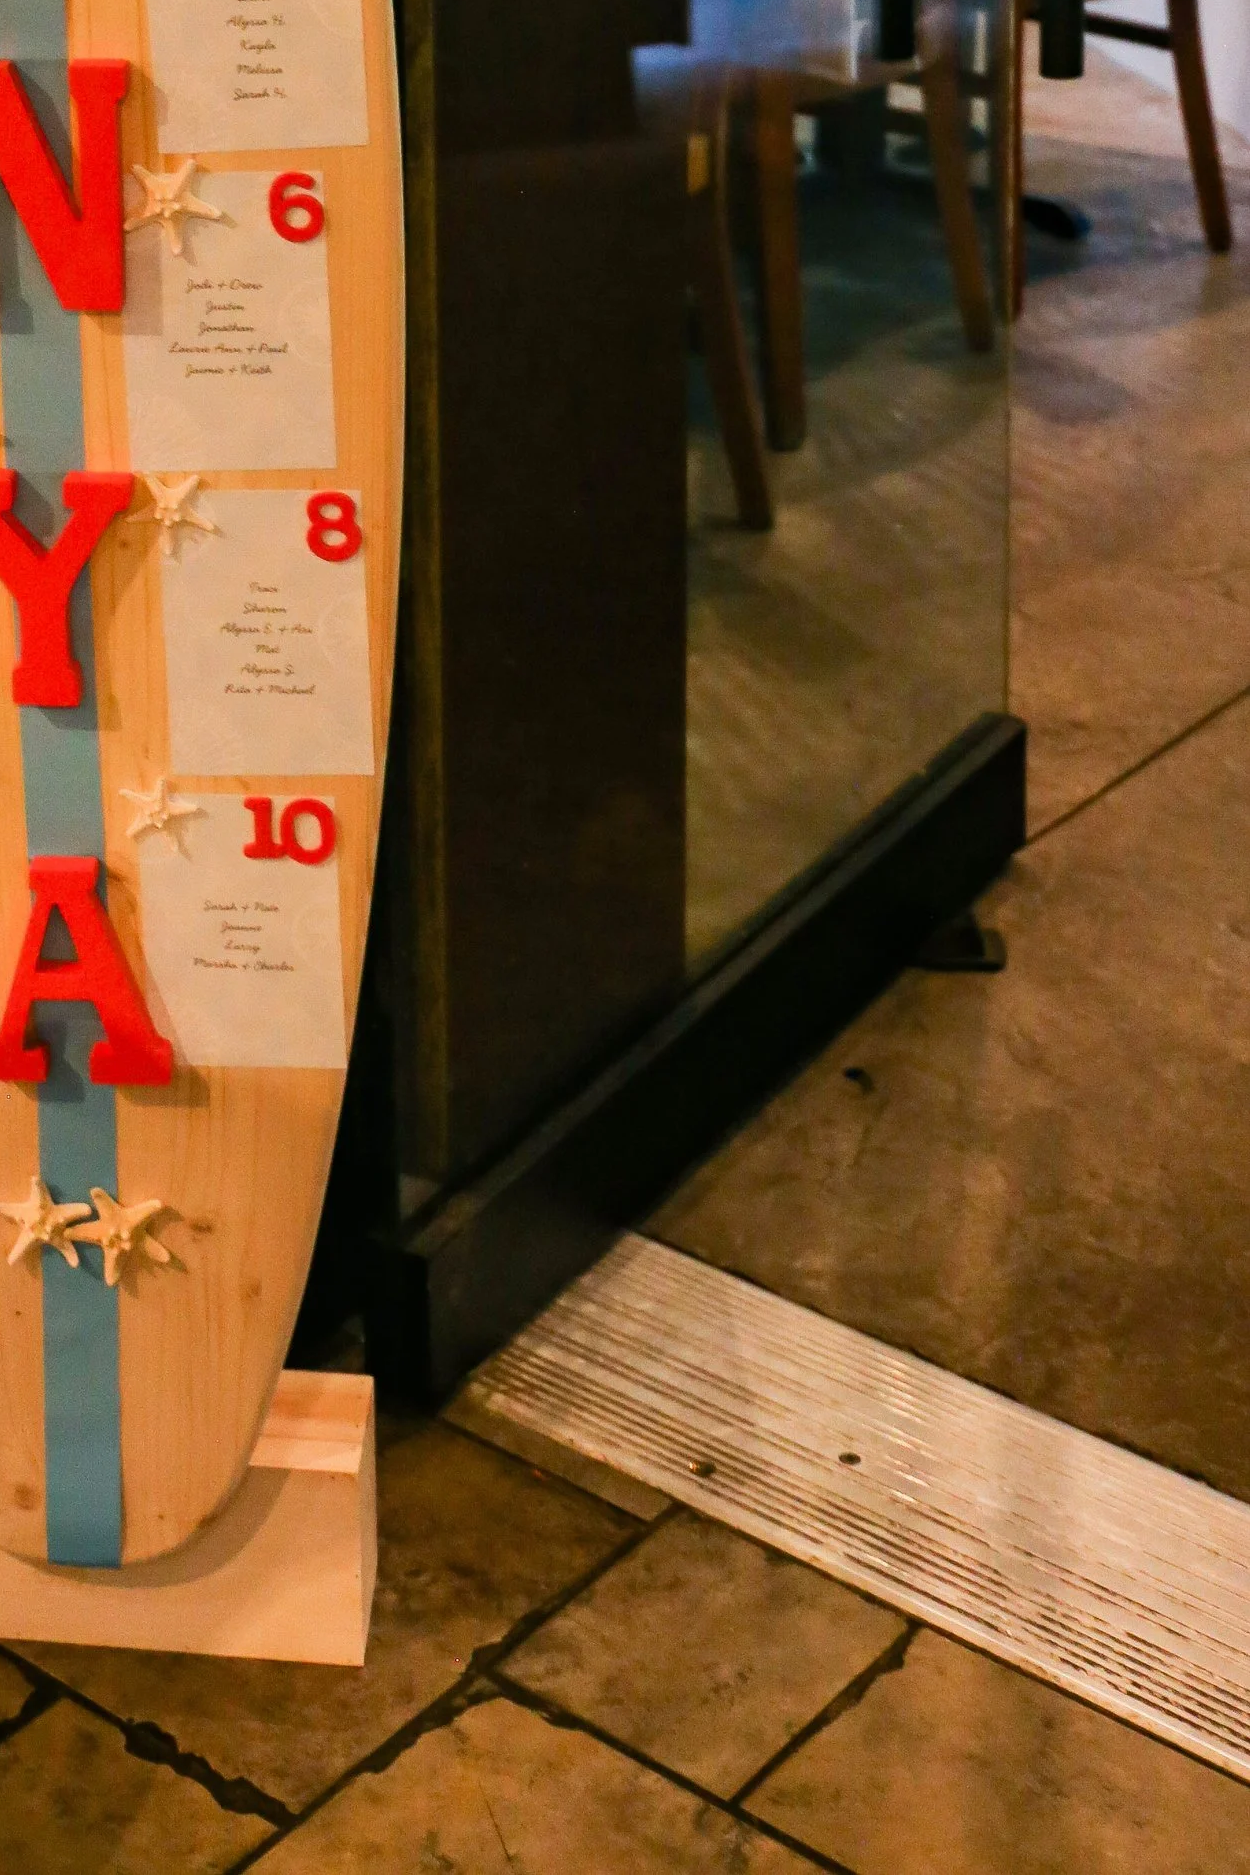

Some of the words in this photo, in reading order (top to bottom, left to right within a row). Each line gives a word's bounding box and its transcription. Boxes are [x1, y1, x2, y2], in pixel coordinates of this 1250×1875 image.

[269, 171, 326, 244] 6
[306, 491, 363, 564] 8
[243, 796, 338, 867] 10
